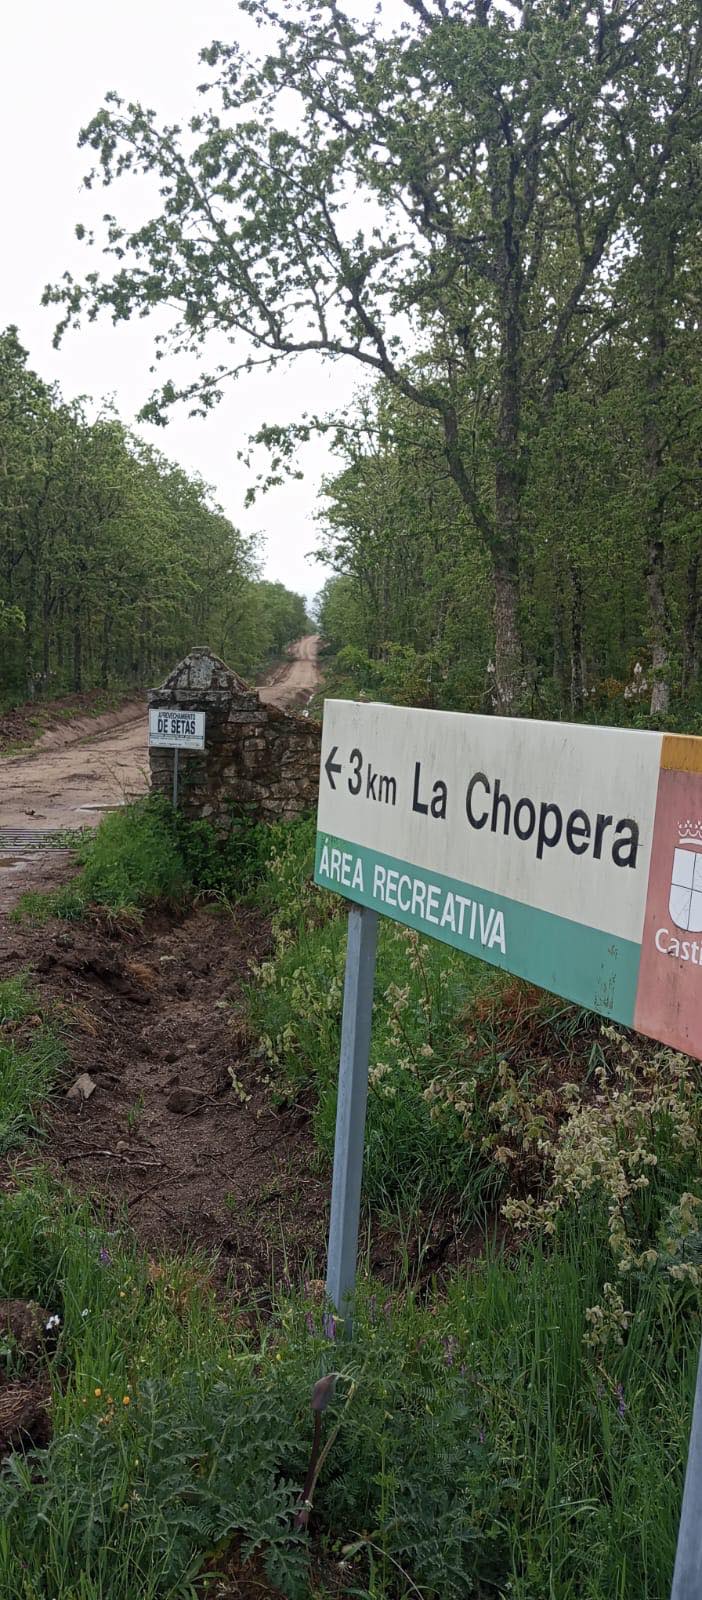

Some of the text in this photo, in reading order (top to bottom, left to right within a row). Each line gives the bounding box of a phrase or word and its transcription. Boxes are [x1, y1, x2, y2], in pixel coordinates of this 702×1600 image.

[157, 719, 196, 735] DE SETAS
[412, 761, 448, 820] La
[465, 771, 640, 870] Chopera
[318, 837, 507, 955] ÁREA RECREATIVA
